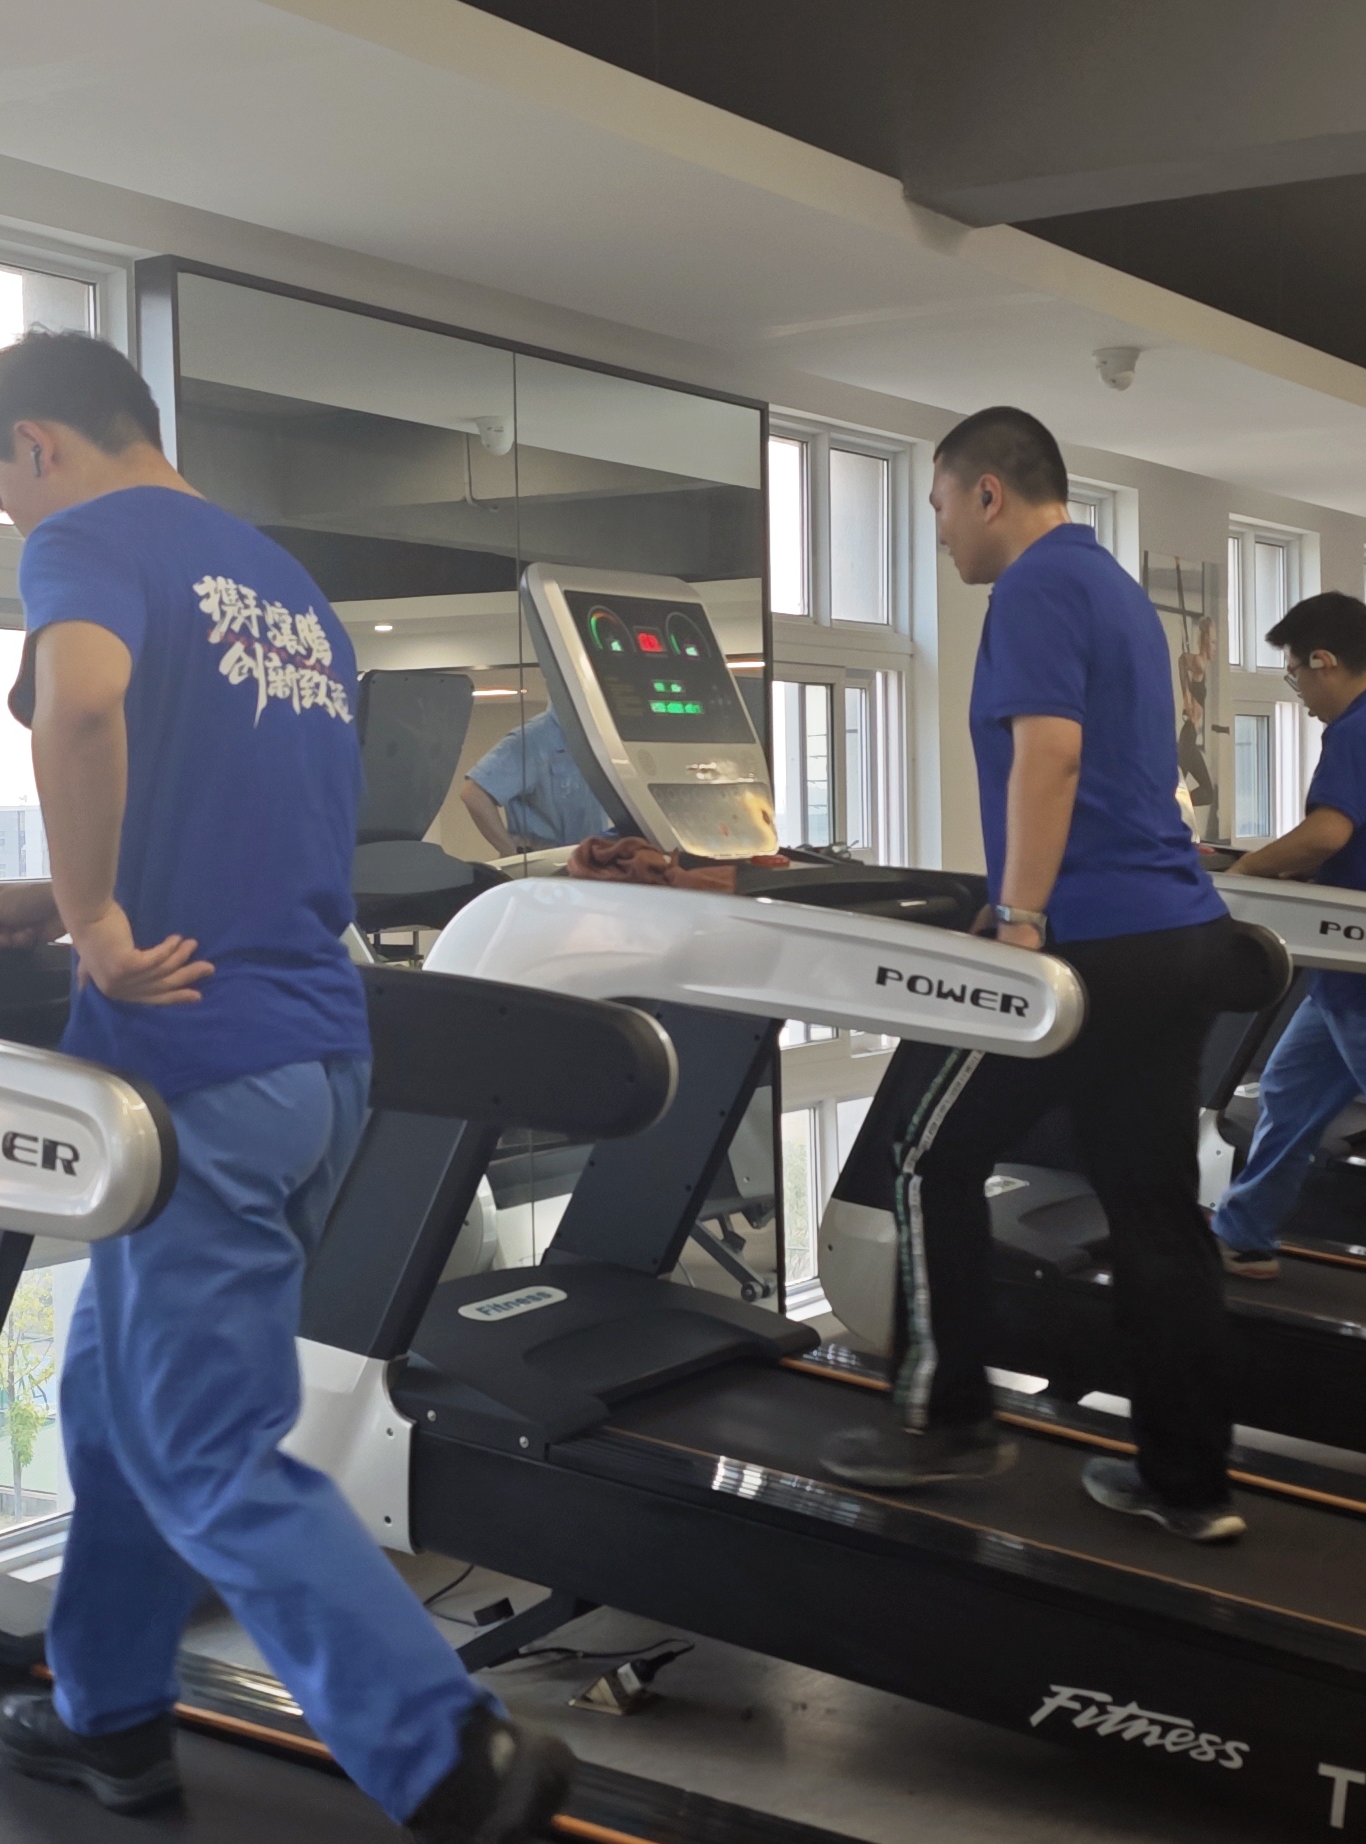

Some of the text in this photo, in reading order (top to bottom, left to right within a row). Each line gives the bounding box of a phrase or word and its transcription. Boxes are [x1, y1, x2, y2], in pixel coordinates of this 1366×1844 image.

[875, 966, 1029, 1018] POWER
[475, 1290, 554, 1317] Fitness
[1029, 1684, 1251, 1770] Fitness
